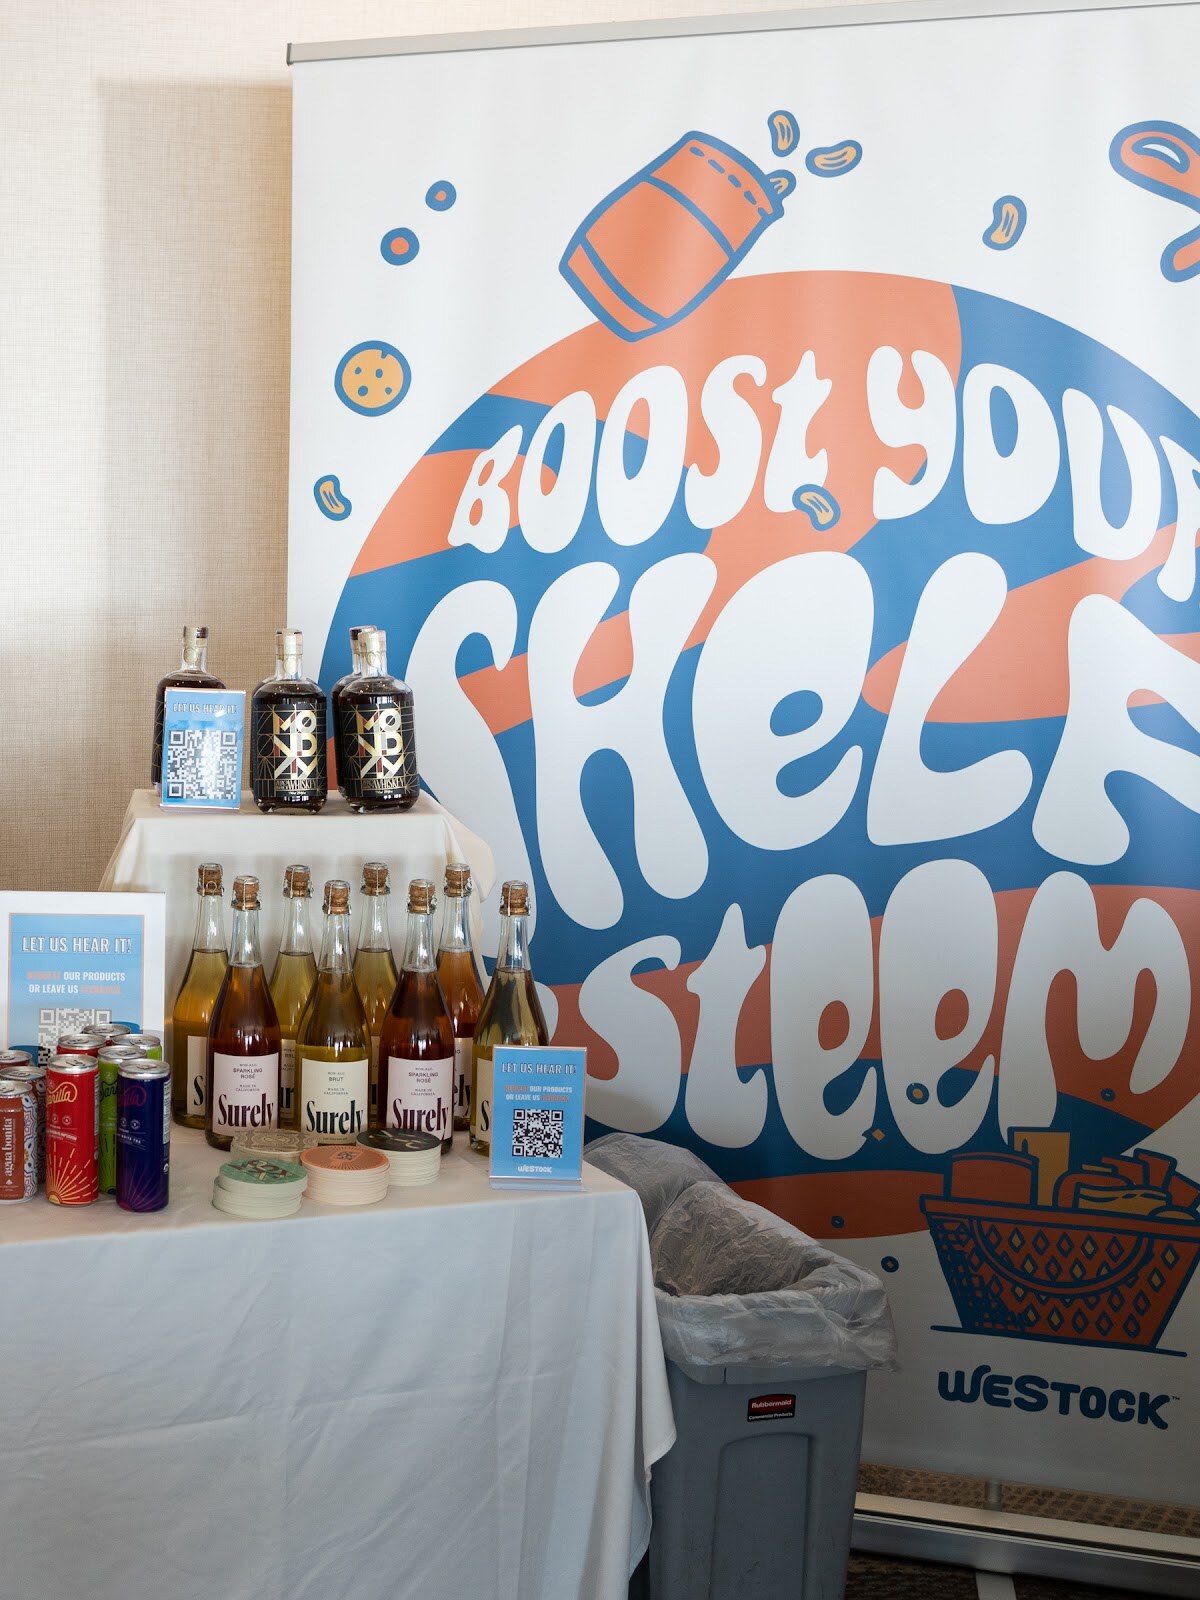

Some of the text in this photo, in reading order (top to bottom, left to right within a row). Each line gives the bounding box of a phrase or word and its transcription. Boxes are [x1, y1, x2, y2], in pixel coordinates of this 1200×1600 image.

[172, 703, 187, 713] LET
[188, 703, 200, 713] US
[21, 936, 133, 953] LET US HEAR IT!
[63, 971, 81, 981] OUR
[83, 971, 126, 982] PRODUCTS
[28, 984, 40, 993] OR
[42, 984, 66, 994] LEAVE
[67, 984, 79, 994] US
[501, 1063, 517, 1073] LET
[520, 1063, 533, 1073] US
[536, 1063, 562, 1074] HEAR
[217, 1093, 274, 1129] Surely
[306, 1100, 364, 1135] Surely
[392, 1097, 449, 1140] Surely
[1, 1118, 14, 1177] agua bonita
[751, 1399, 792, 1409] Rubbermaid
